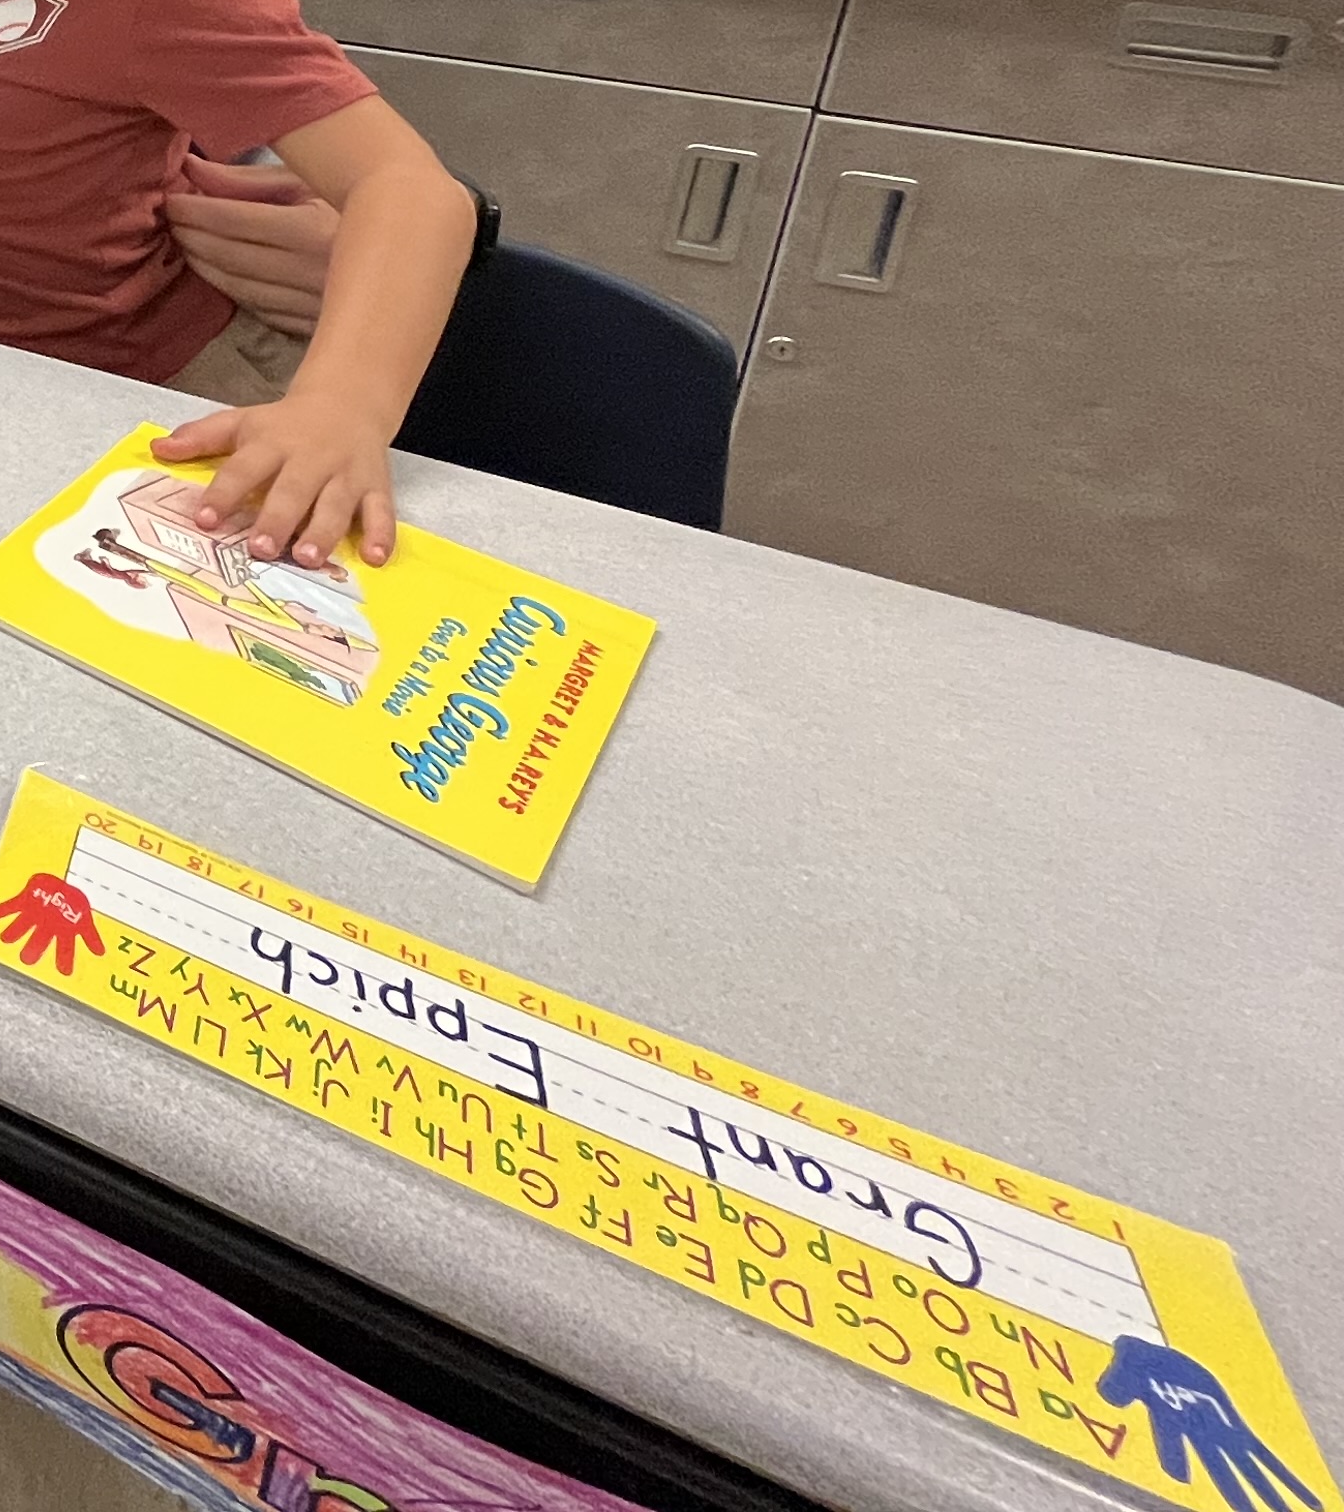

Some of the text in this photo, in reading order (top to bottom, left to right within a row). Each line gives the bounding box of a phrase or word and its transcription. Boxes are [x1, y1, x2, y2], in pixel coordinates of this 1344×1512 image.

[381, 618, 466, 715] Goes to a Movie
[391, 596, 564, 803] Curious George
[542, 713, 567, 728] &
[550, 639, 602, 715] MARGRET
[31, 885, 84, 924] Right
[79, 812, 1126, 1247] 1 2 3 4 5 6 7 8 9 10 11 12 13 14 15 16 17 18 19 20
[250, 926, 982, 1290] Grant Eppich
[109, 973, 1128, 1461] Aa Bb Cc Dd Ee Ff Gg Hh Ii Jj Kk Ll Mm
[117, 935, 1075, 1386] Nn Oo Pp Qq Rr Ss Tt Uu Vv Ww Xx Yy Zz
